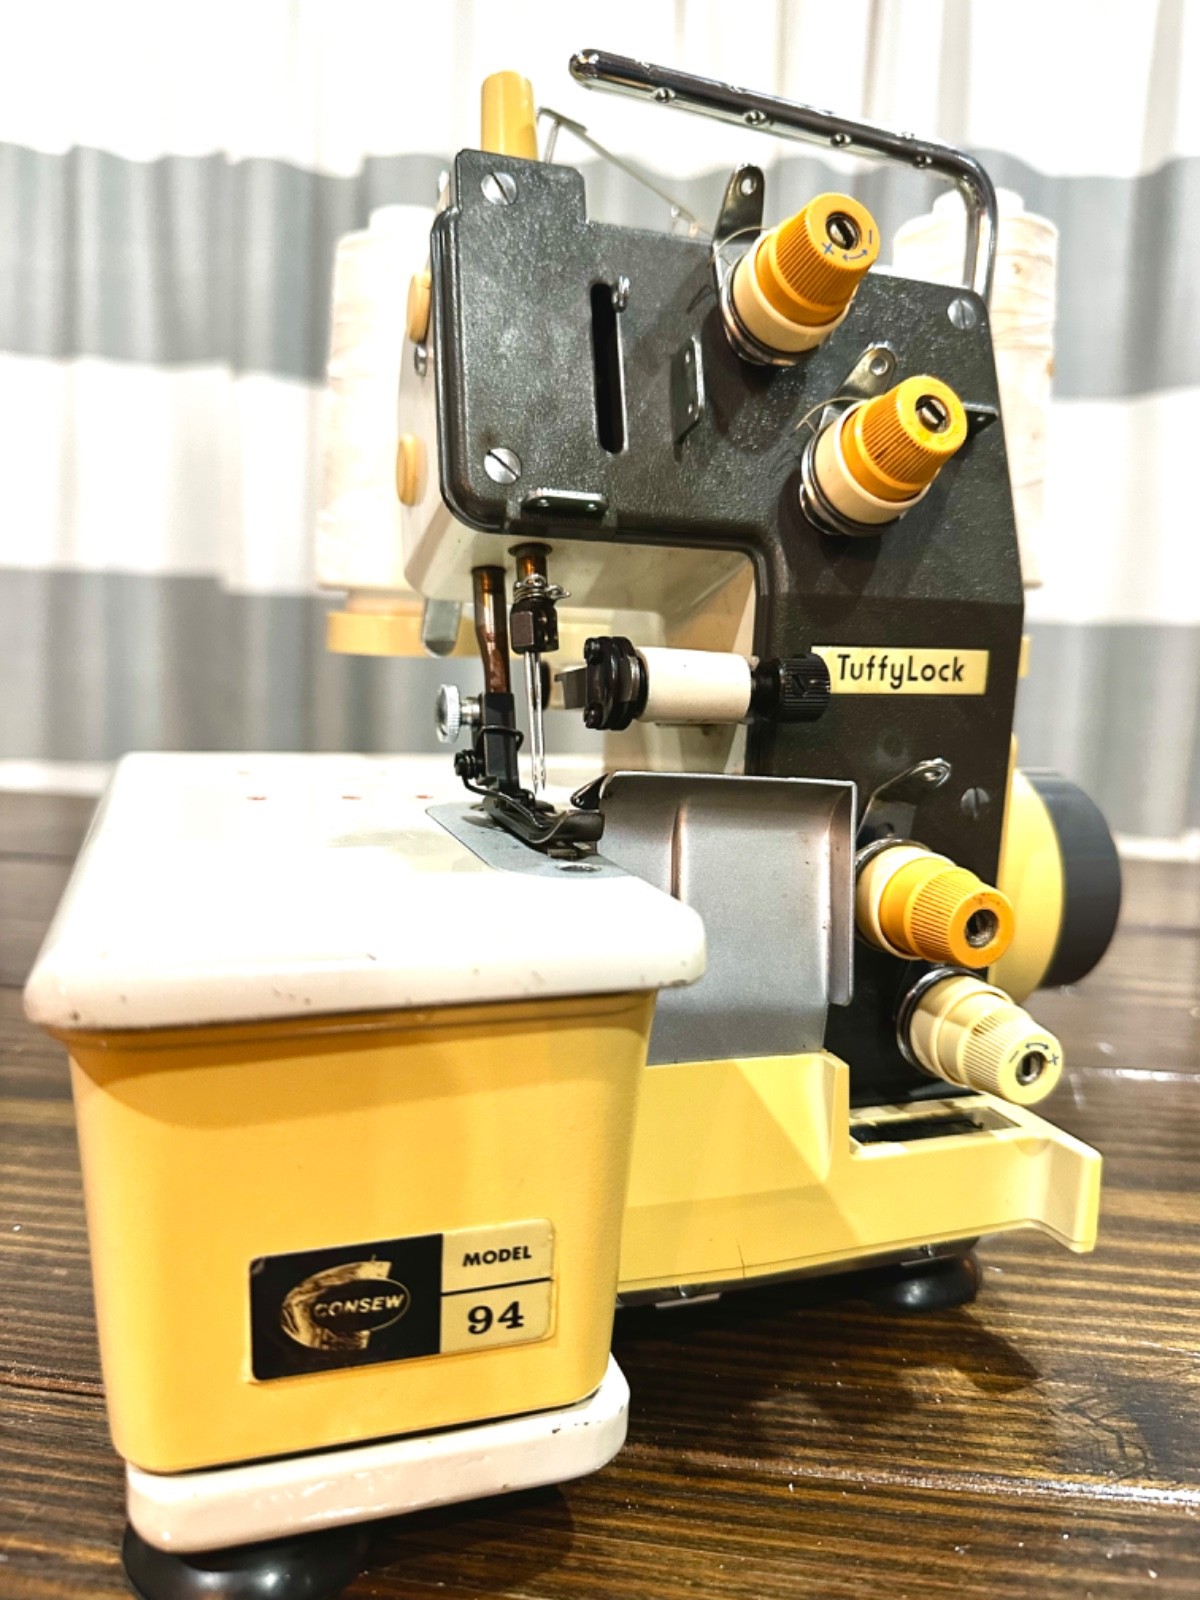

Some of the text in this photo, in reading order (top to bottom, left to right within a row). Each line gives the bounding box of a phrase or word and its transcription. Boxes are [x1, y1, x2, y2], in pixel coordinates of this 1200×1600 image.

[837, 654, 965, 689] TuffyLock
[462, 1246, 532, 1267] MODEL
[313, 1294, 405, 1317] CONSEW
[467, 1301, 524, 1335] 94
